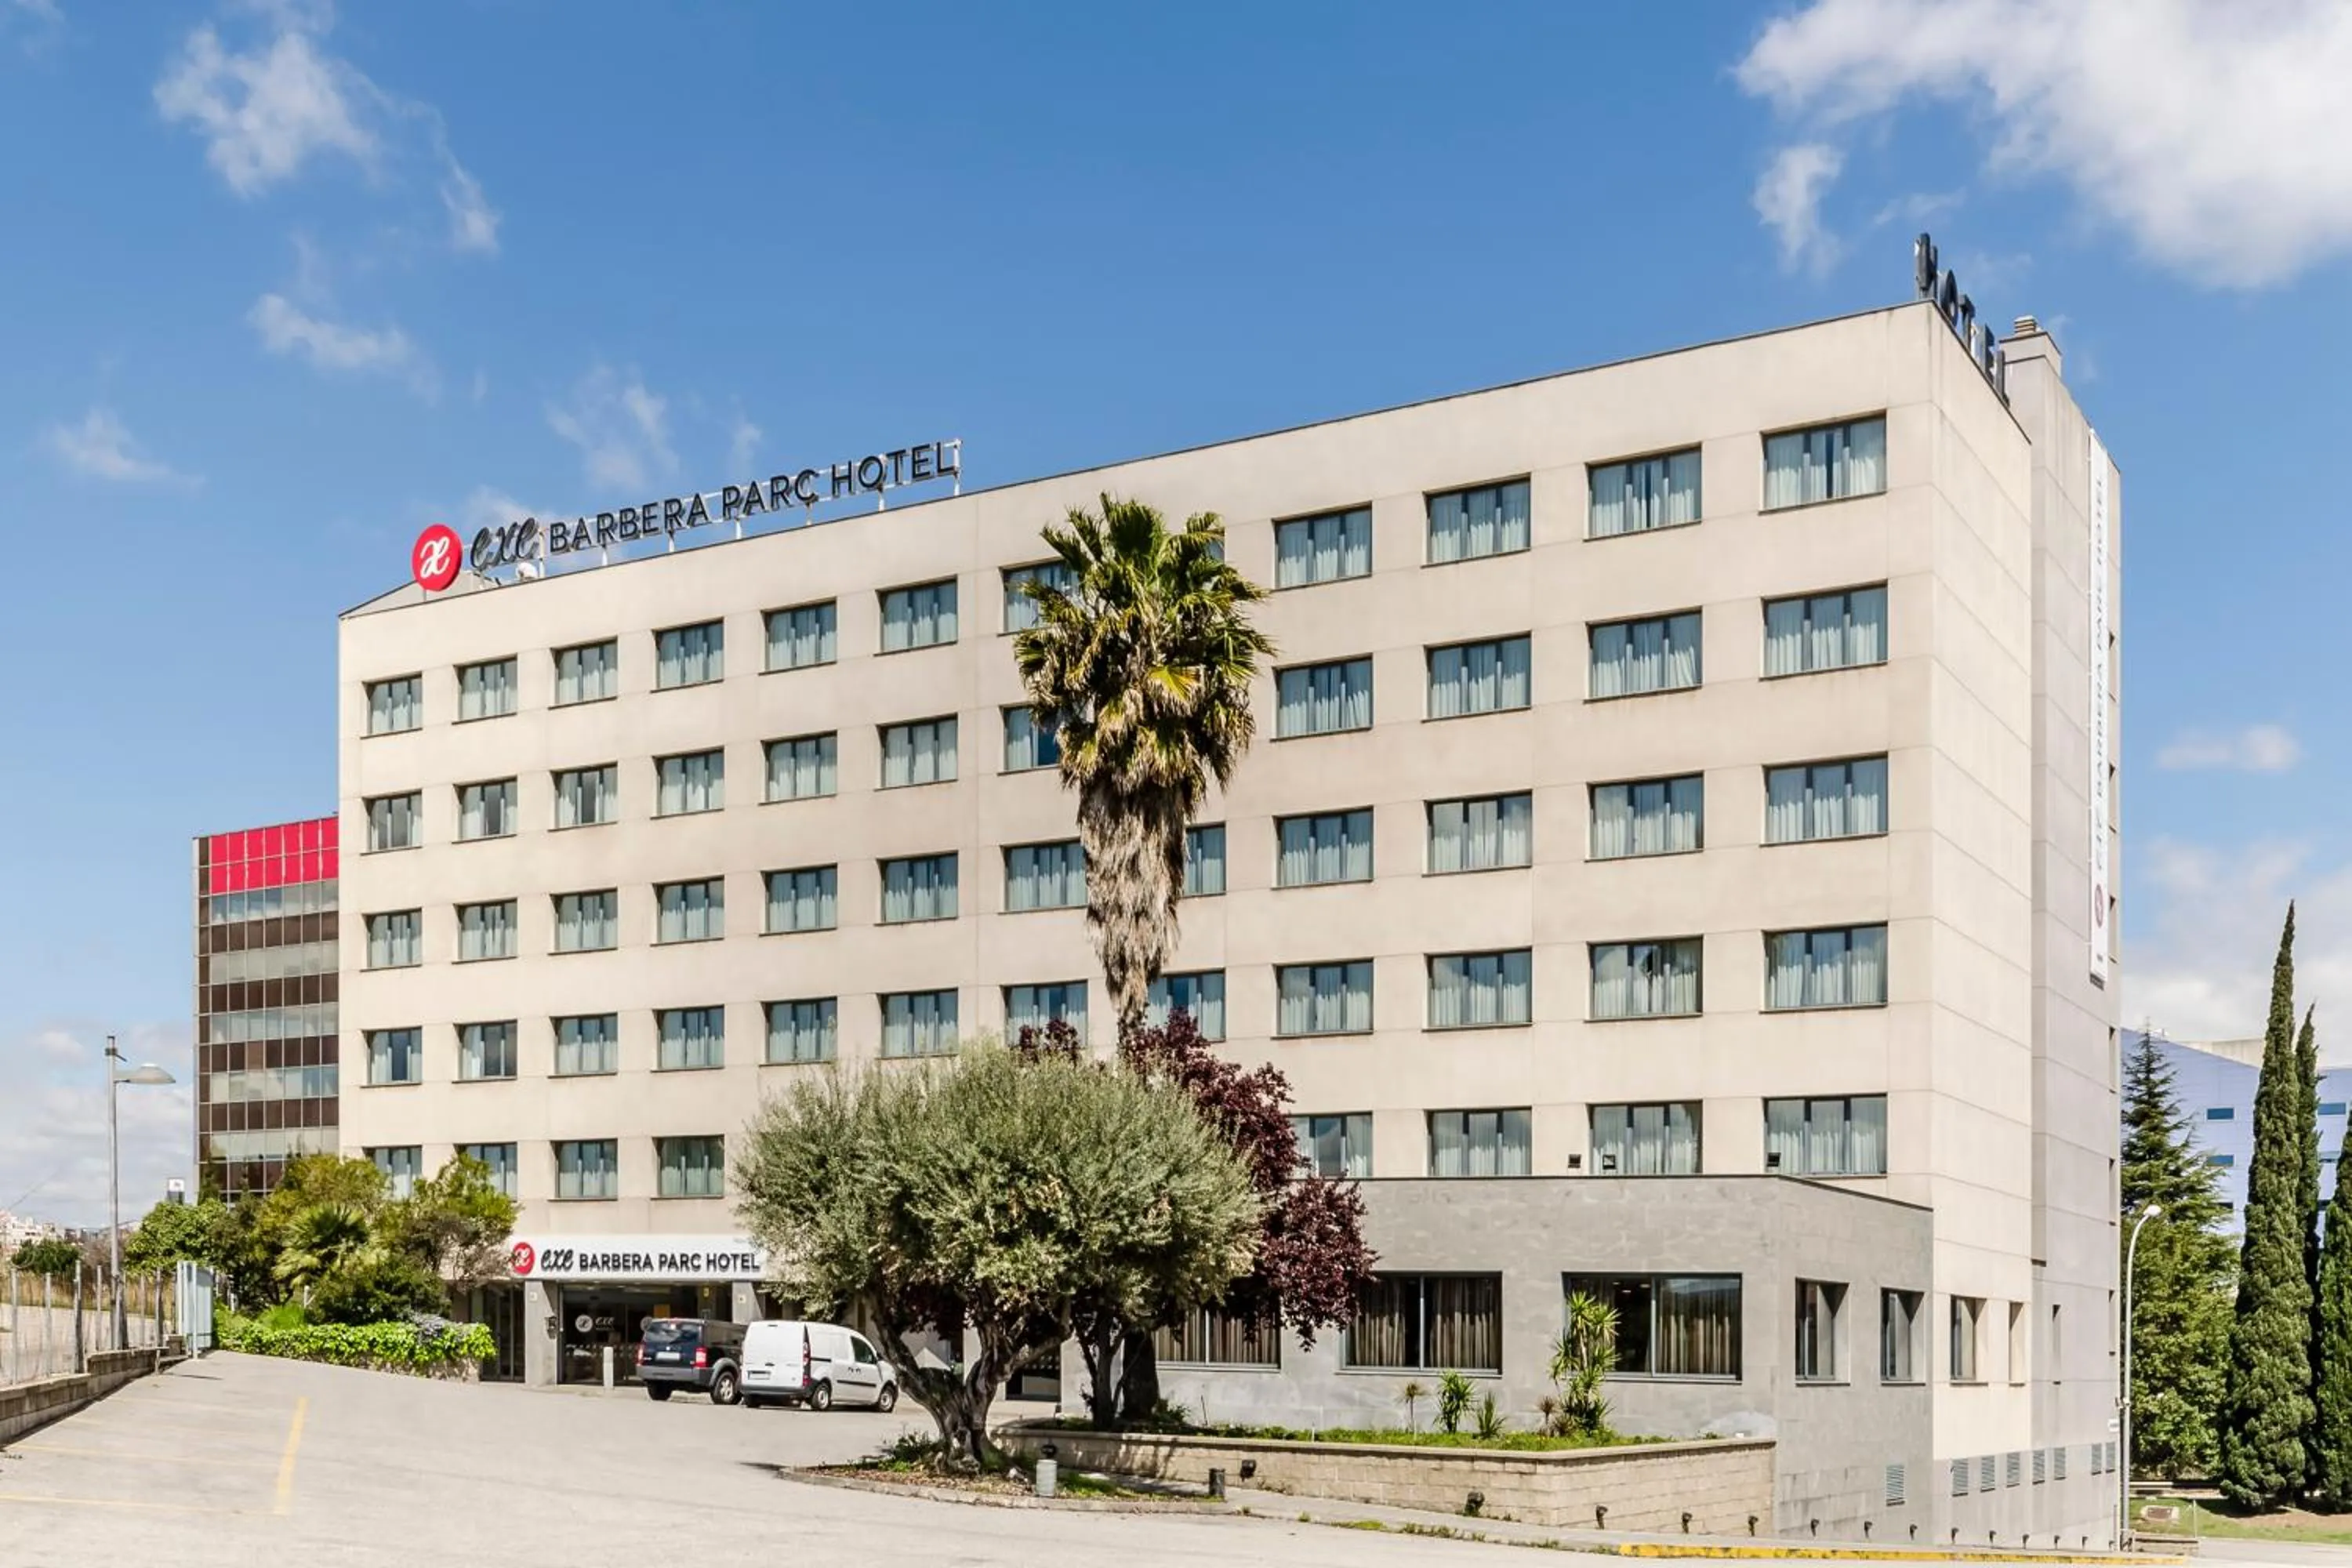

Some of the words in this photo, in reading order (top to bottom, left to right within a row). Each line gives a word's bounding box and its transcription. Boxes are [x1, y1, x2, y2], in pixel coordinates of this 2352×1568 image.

[550, 492, 710, 554] BARBERA
[722, 469, 818, 520] PARC
[831, 441, 956, 498] HOTEL
[541, 1249, 574, 1272] exe
[579, 1253, 654, 1272] BARBERA
[659, 1253, 702, 1272] PARC
[706, 1253, 760, 1272] HOTEL
